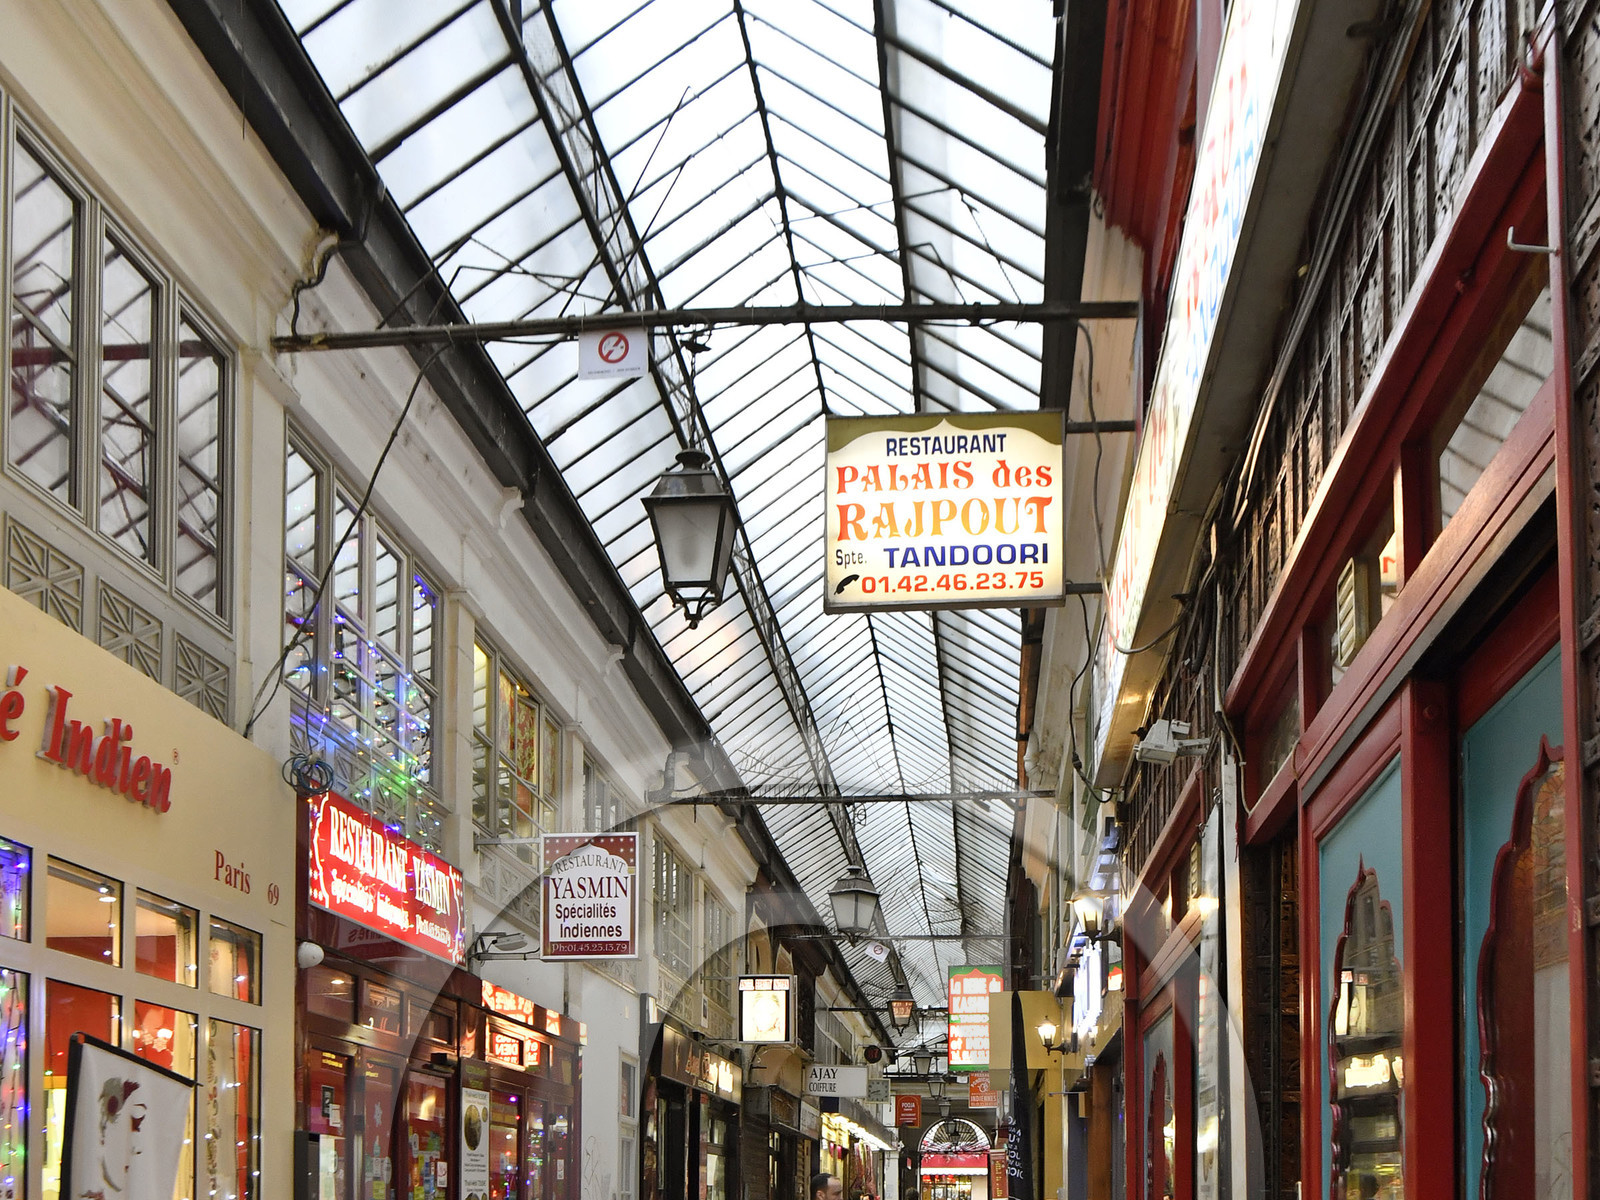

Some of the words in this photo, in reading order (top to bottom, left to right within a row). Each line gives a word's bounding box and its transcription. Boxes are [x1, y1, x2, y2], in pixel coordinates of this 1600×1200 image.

[886, 433, 1007, 457] RESTAURANT
[836, 460, 974, 495] PALAIS
[992, 459, 1053, 488] des
[836, 496, 1053, 542] RAJPOUT
[883, 543, 1049, 569] TANDOORI
[861, 571, 1044, 594] 01.42.46.23.75
[40, 684, 173, 814] Indien
[329, 805, 408, 893] RESTAURANT
[412, 855, 451, 917] YASMIN
[554, 854, 625, 875] RESTAURANT
[214, 849, 251, 895] Paris
[267, 882, 280, 906] 69
[550, 876, 629, 899] YASMIN
[555, 902, 617, 922] Spécialités
[560, 922, 622, 938] Indiennes
[809, 1068, 838, 1081] AJAY
[808, 1082, 837, 1093] COIFFURE
